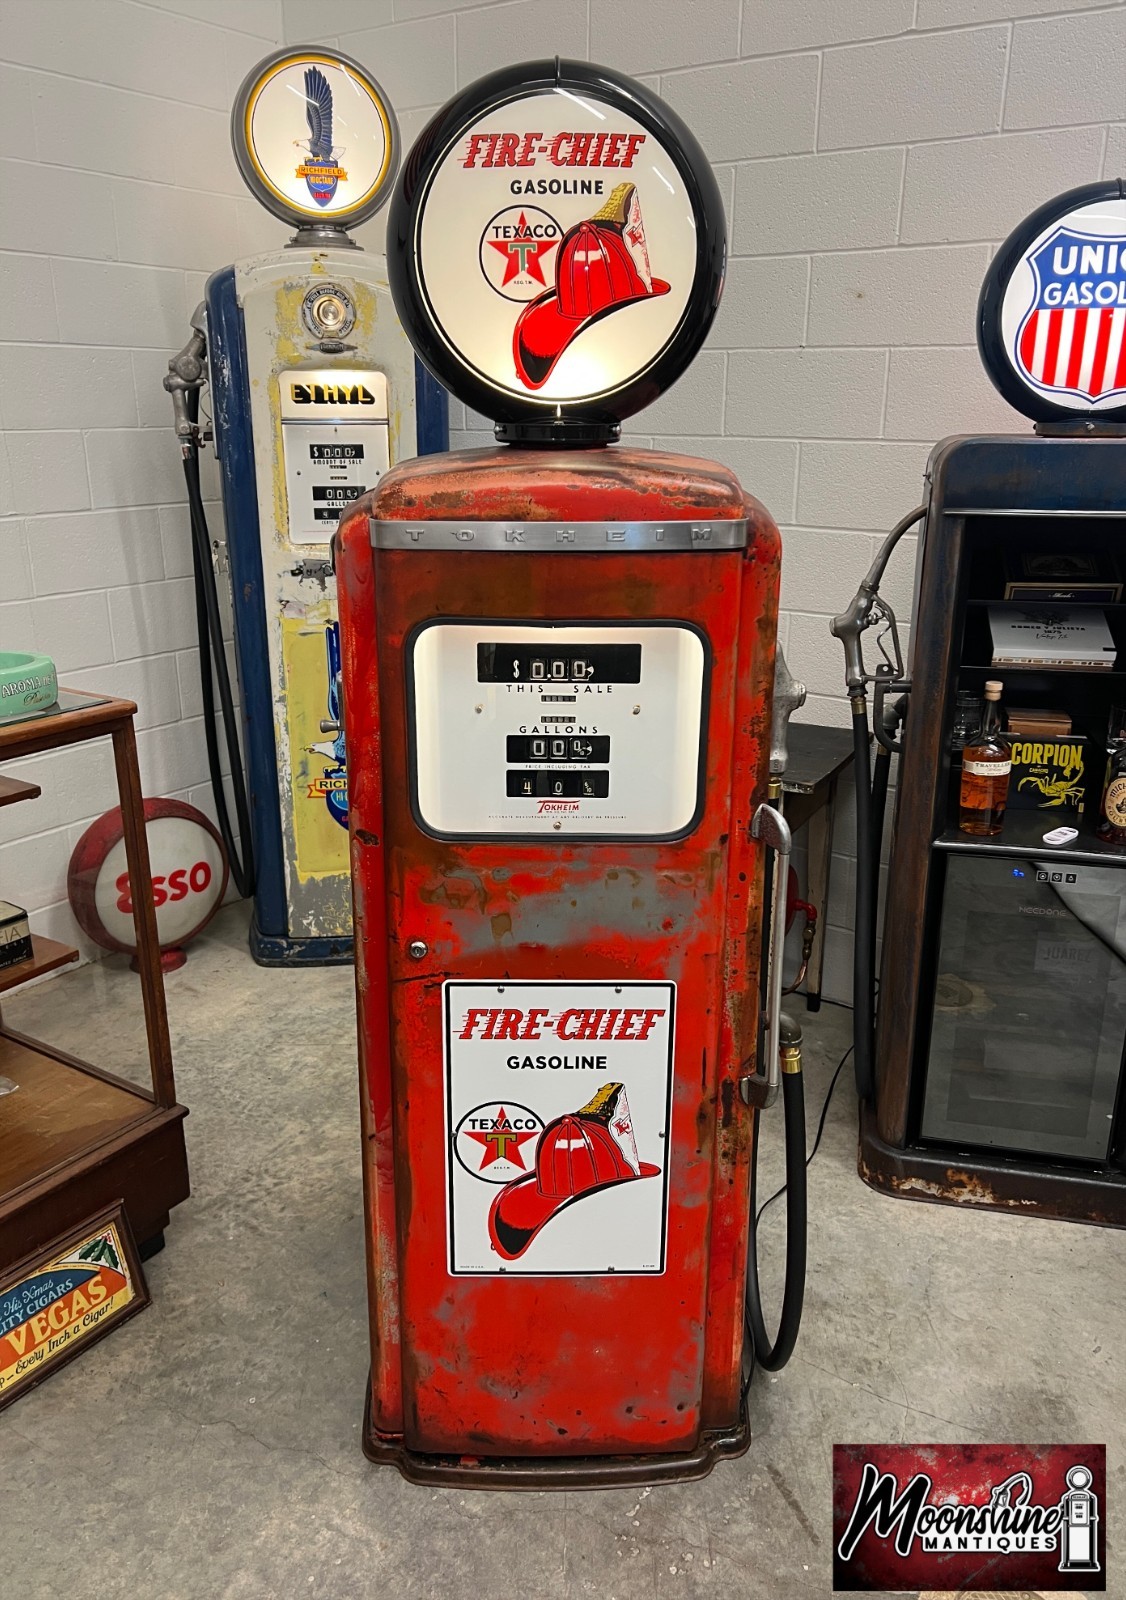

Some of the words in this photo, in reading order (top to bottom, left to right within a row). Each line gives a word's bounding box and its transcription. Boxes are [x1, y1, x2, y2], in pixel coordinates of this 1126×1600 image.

[460, 132, 646, 168] FIRE-CHIEF
[301, 166, 342, 175] RICHFIELD
[510, 179, 604, 195] GASOLINE
[492, 224, 557, 239] TEXACO
[290, 383, 375, 404] ETHYL
[406, 528, 712, 543] TOKHEIM
[513, 660, 520, 679] $
[2, 675, 42, 699] AROMA
[506, 685, 544, 693] THIS
[574, 685, 613, 693] SALE
[519, 725, 598, 735] GALLONS
[1010, 743, 1083, 769] CORPION
[537, 800, 580, 813] TOKHEIM
[457, 1008, 667, 1041] FIRE-CHIEF
[506, 1056, 607, 1069] GASOLINE
[468, 1118, 537, 1130] TEXACO
[26, 1278, 74, 1315] CIGARS
[3, 1297, 22, 1317] His
[5, 1275, 107, 1356] VEGAS
[15, 1348, 45, 1375] Every
[47, 1328, 71, 1353] Inch
[73, 1323, 81, 1335] a
[82, 1296, 114, 1327] Cigar!
